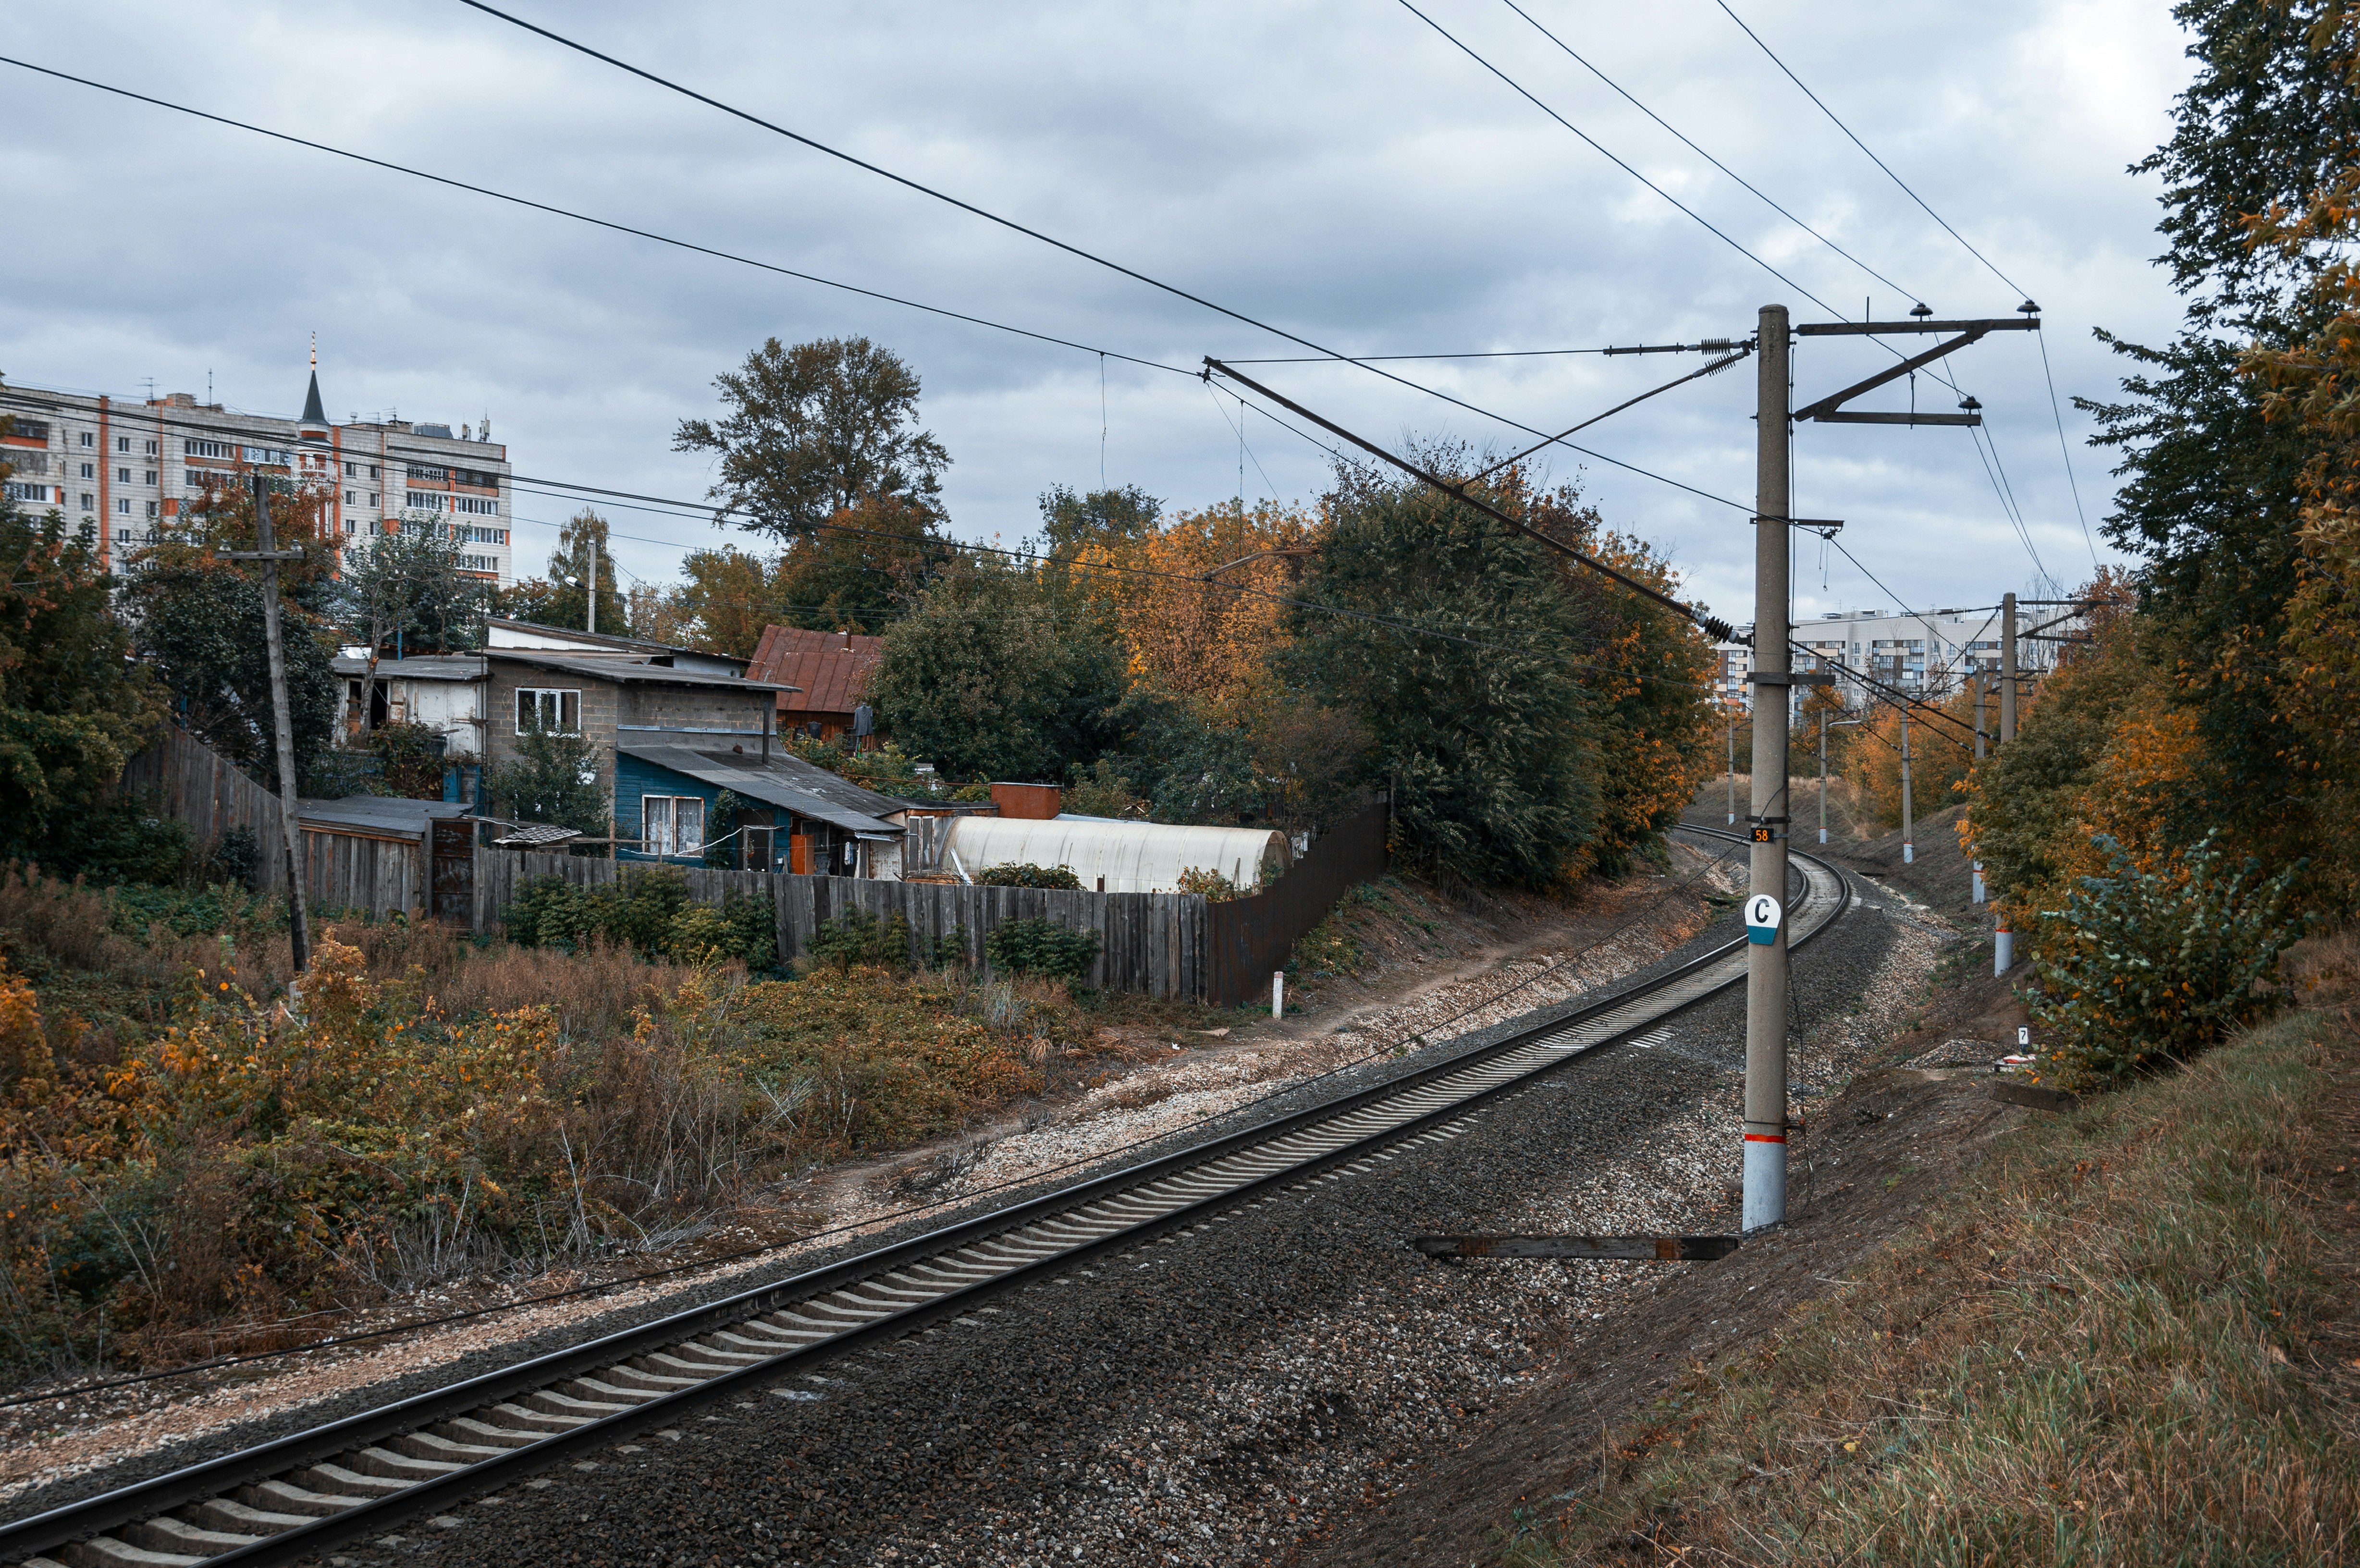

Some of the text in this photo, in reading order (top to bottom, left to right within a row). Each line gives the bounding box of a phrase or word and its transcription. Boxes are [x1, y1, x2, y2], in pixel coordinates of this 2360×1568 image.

[1756, 830, 1768, 841] 58
[1755, 899, 1769, 923] С
[2021, 1030, 2026, 1040] 7
